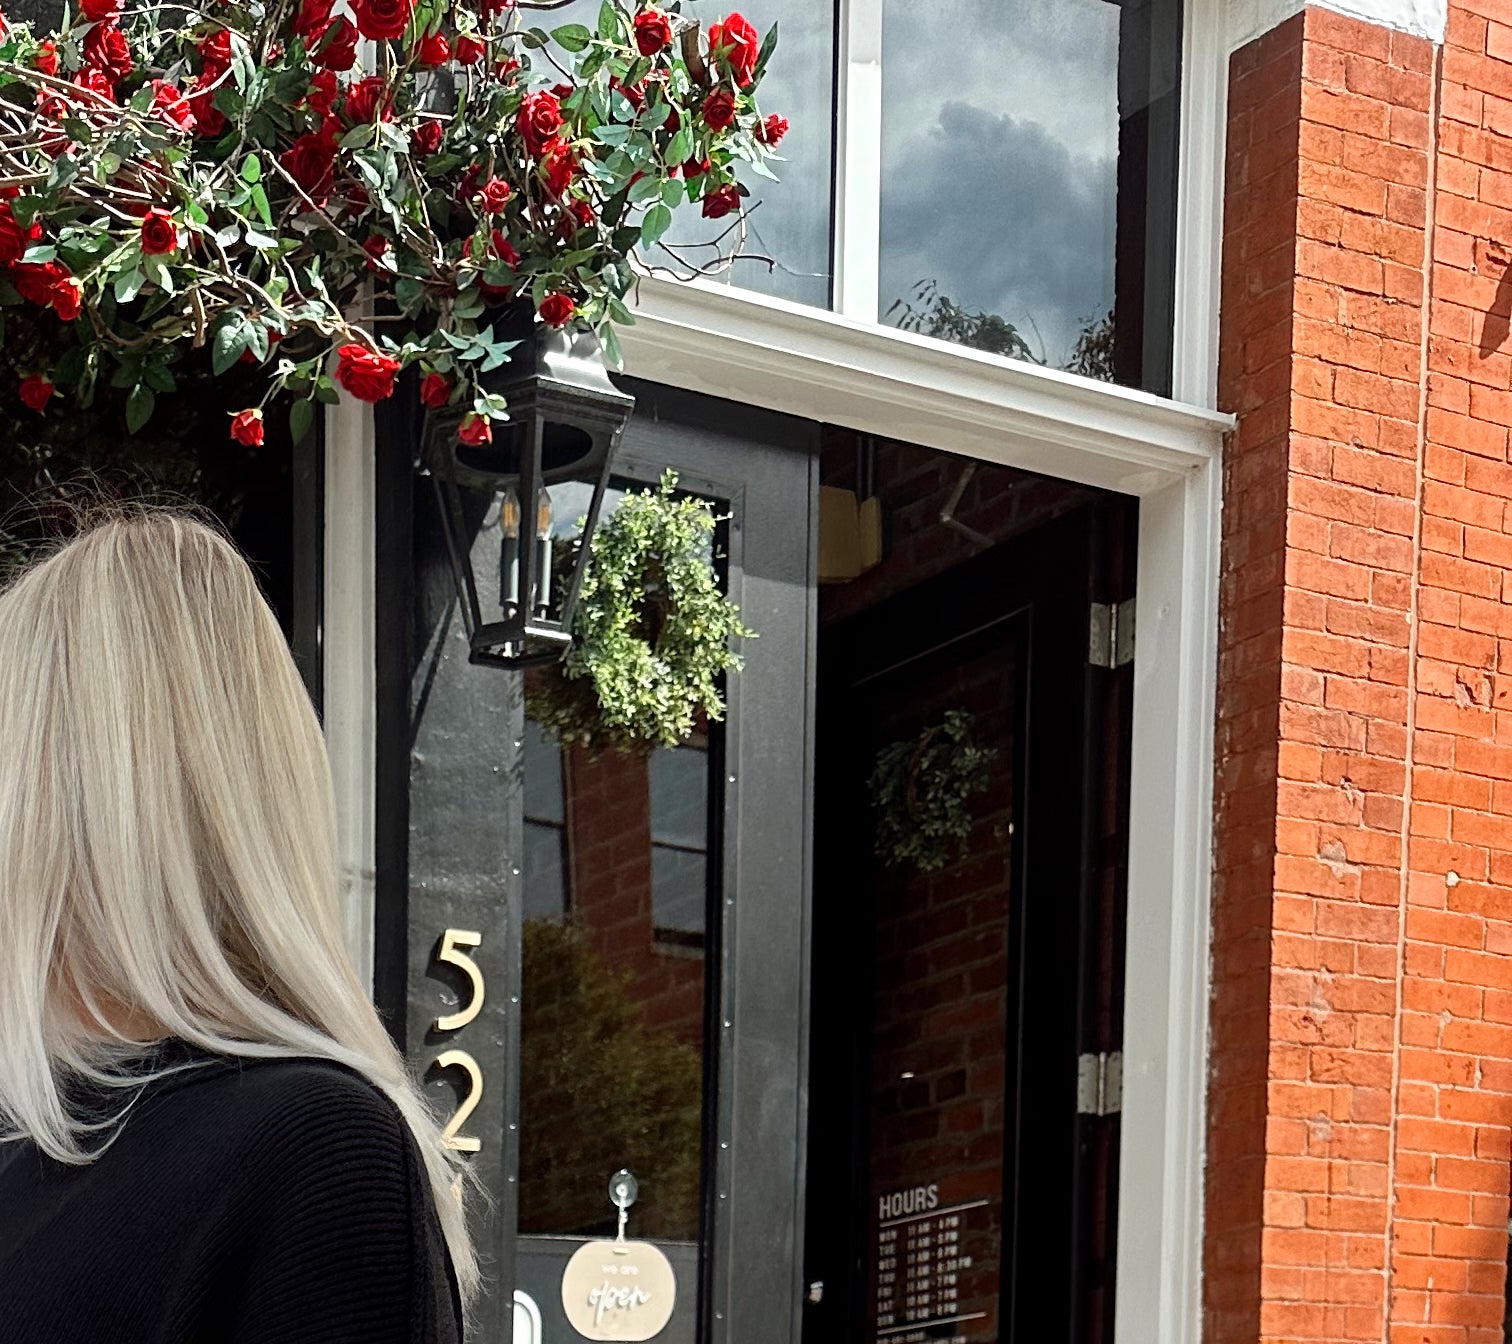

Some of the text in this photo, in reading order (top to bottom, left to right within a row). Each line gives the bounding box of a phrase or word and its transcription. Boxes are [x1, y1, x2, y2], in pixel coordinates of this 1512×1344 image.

[879, 1185, 938, 1219] HOURS
[601, 1264, 639, 1275] we are
[588, 1280, 652, 1326] open
